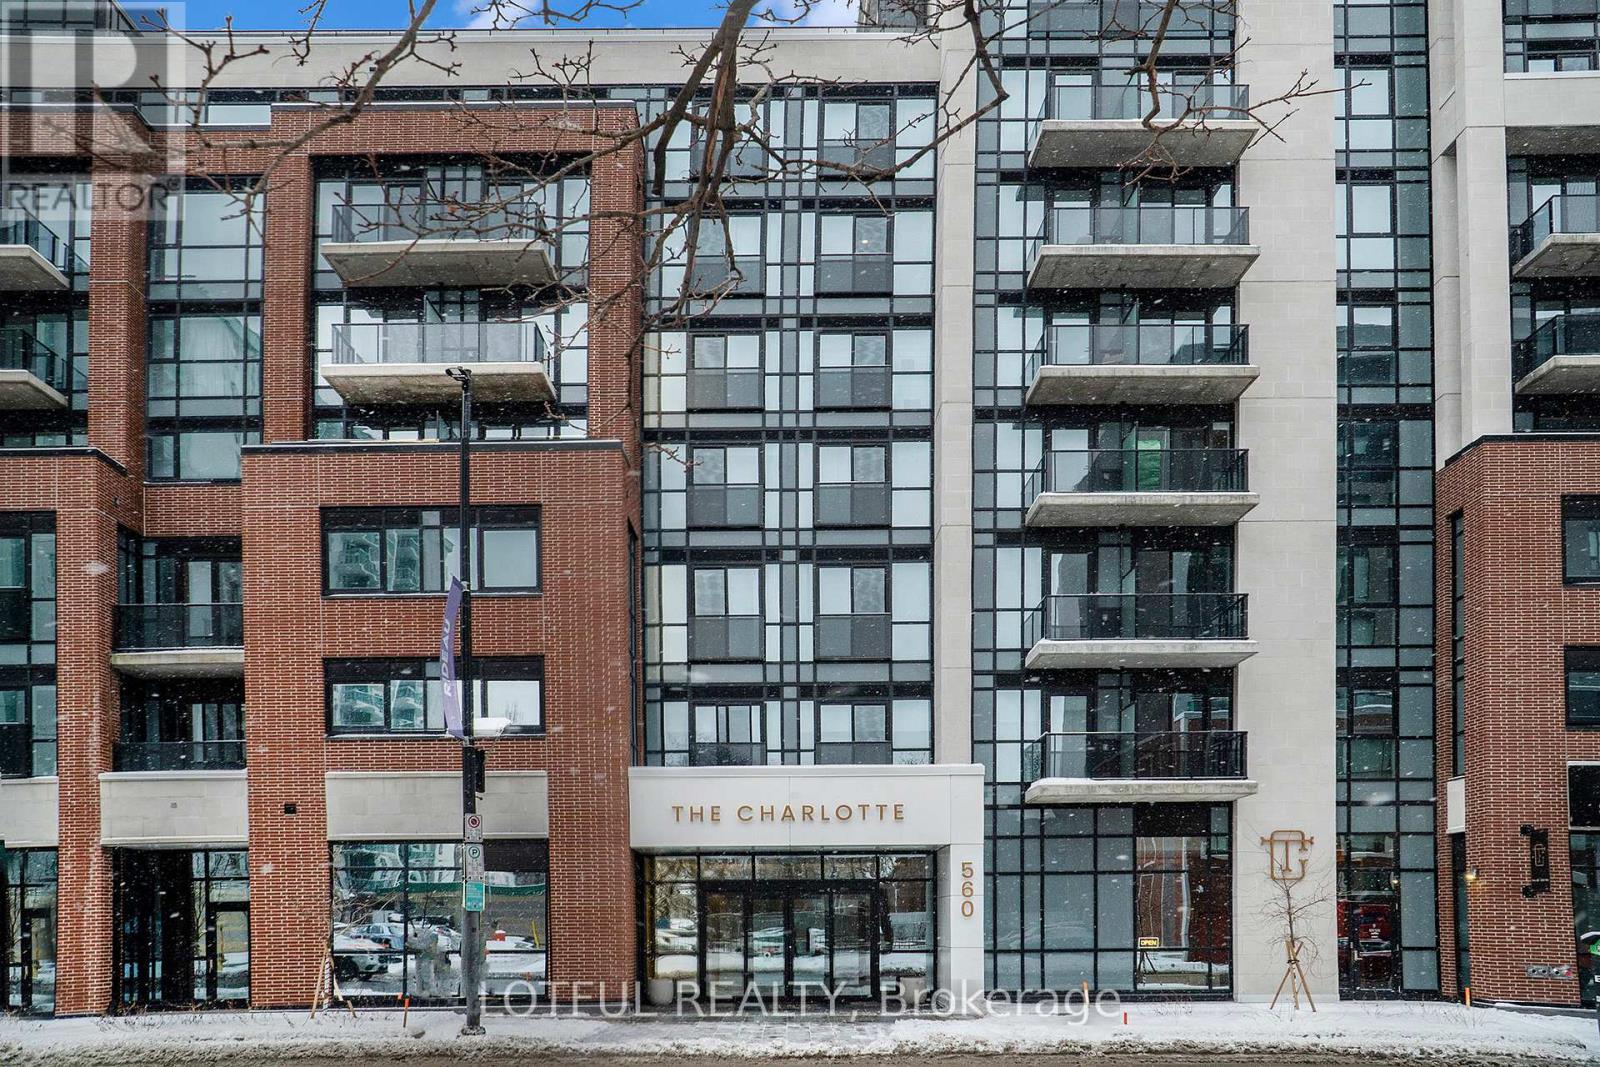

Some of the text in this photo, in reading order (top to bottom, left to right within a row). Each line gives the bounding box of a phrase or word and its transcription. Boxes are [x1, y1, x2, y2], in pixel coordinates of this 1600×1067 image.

[672, 804, 906, 822] THE CHARLOTTE
[961, 862, 975, 918] 560
